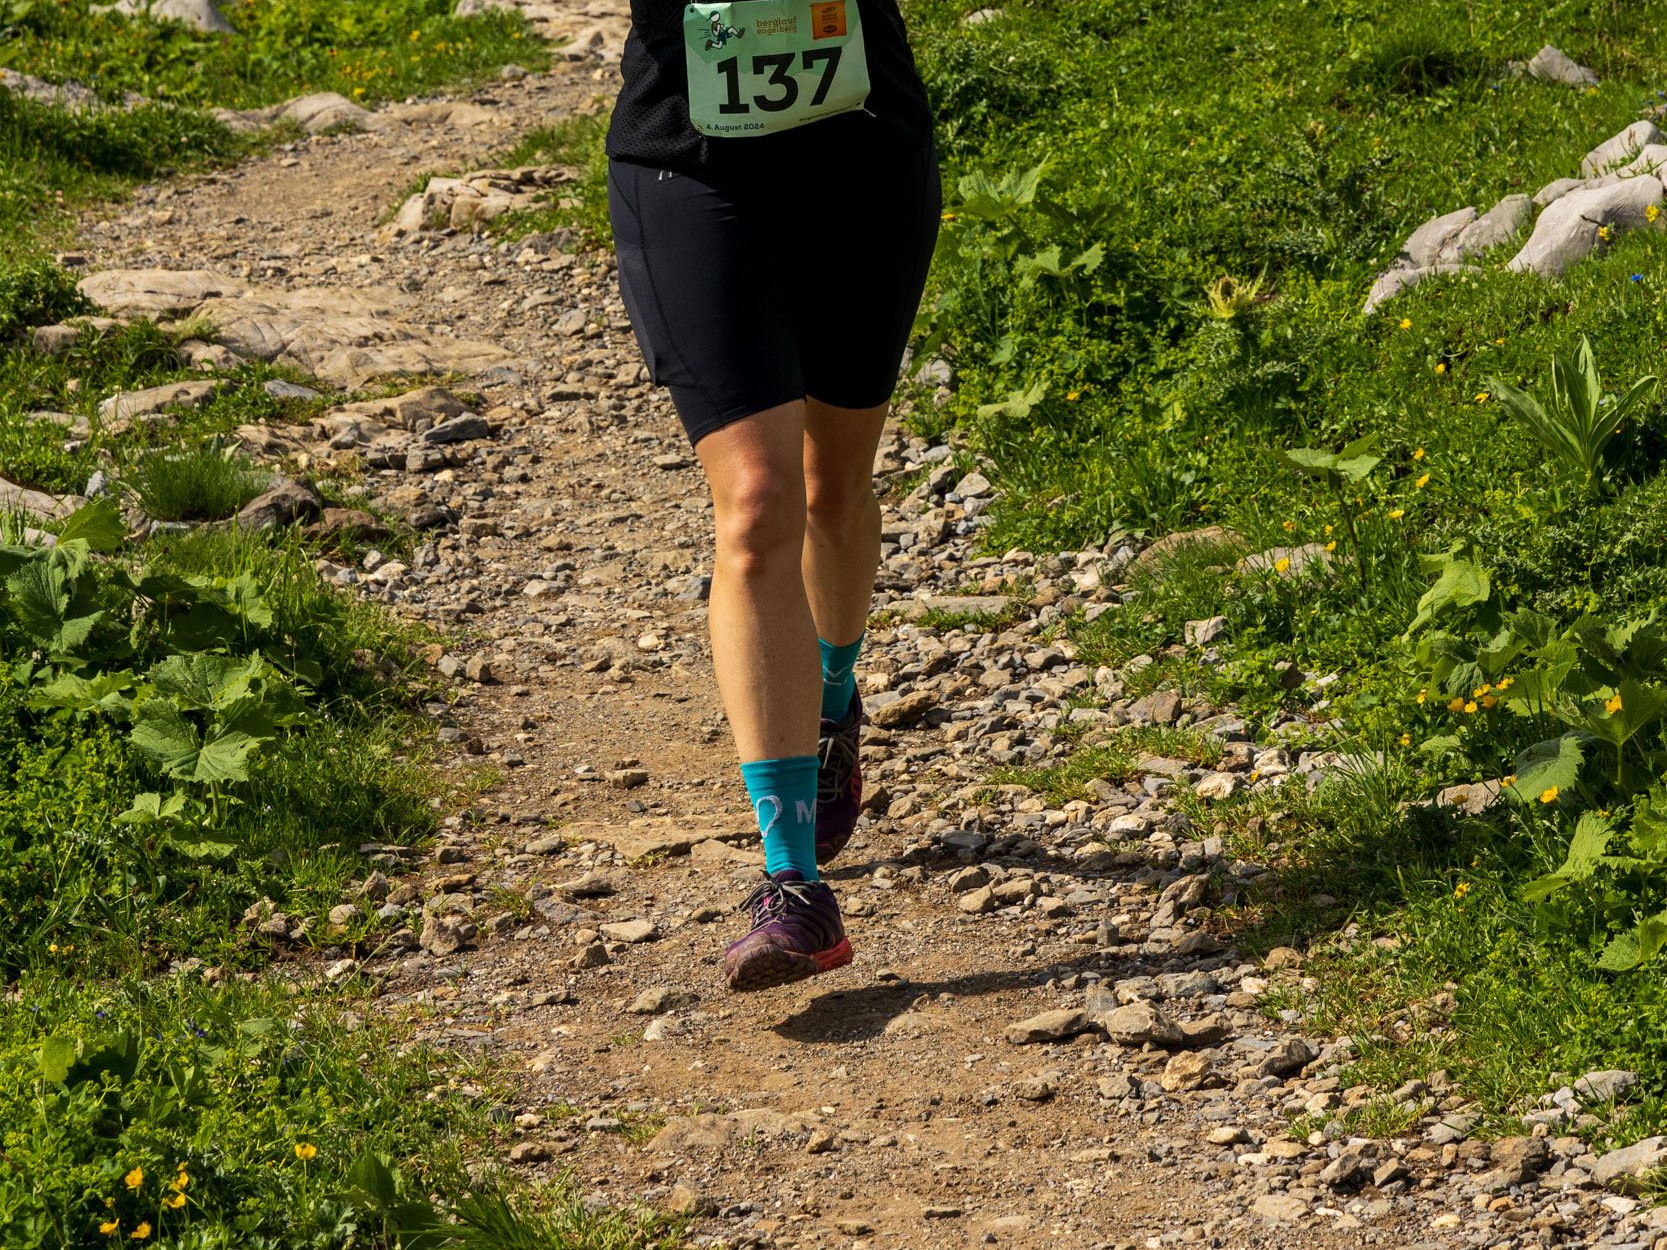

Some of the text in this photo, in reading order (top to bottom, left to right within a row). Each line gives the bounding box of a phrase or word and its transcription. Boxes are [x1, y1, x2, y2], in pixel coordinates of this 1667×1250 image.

[756, 15, 797, 28] berglauf
[756, 25, 797, 36] engelberg
[717, 46, 842, 114] 137
[714, 124, 742, 133] August
[743, 122, 765, 130] 2024
